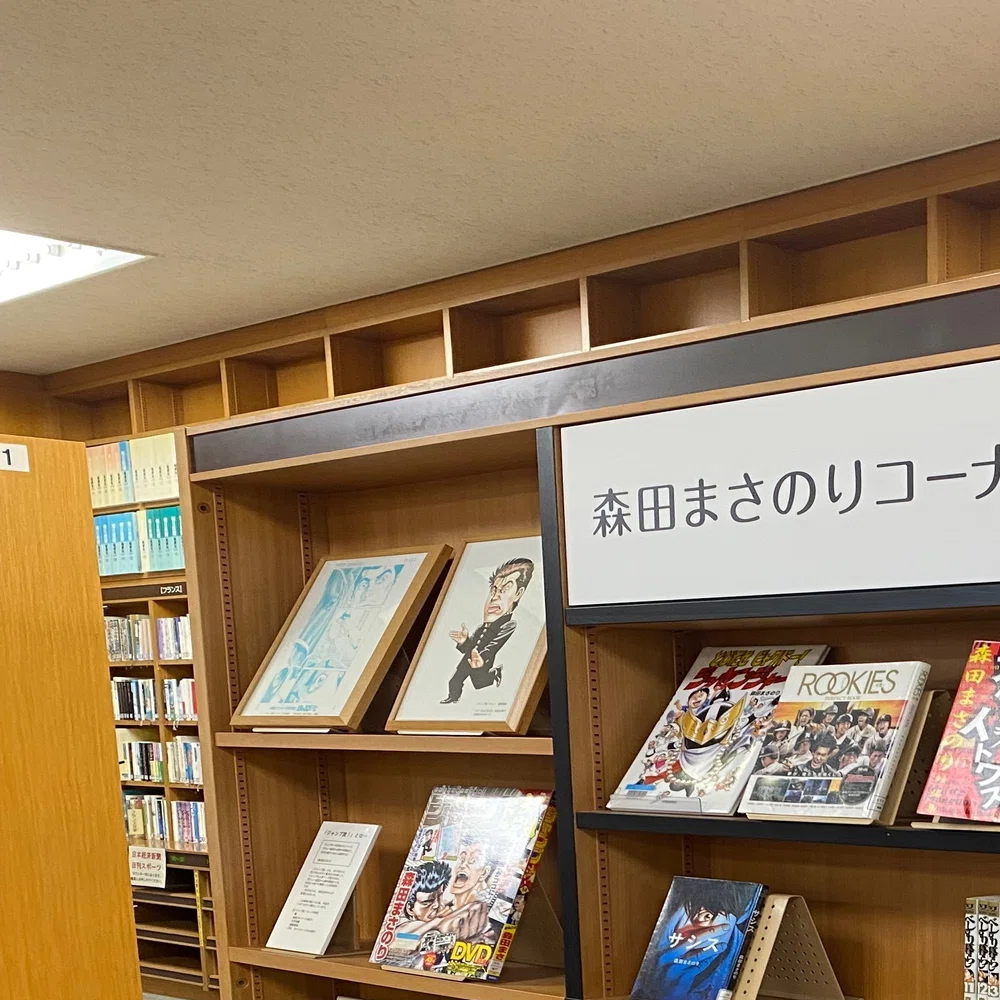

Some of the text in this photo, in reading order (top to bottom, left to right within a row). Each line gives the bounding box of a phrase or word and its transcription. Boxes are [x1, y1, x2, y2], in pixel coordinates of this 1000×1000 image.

[797, 669, 899, 696] ROOKIES
[376, 871, 417, 961] 森田まさのり
[451, 941, 492, 964] DVD
[964, 981, 975, 993] 11
[977, 982, 988, 994] 12
[988, 985, 999, 997] 13
